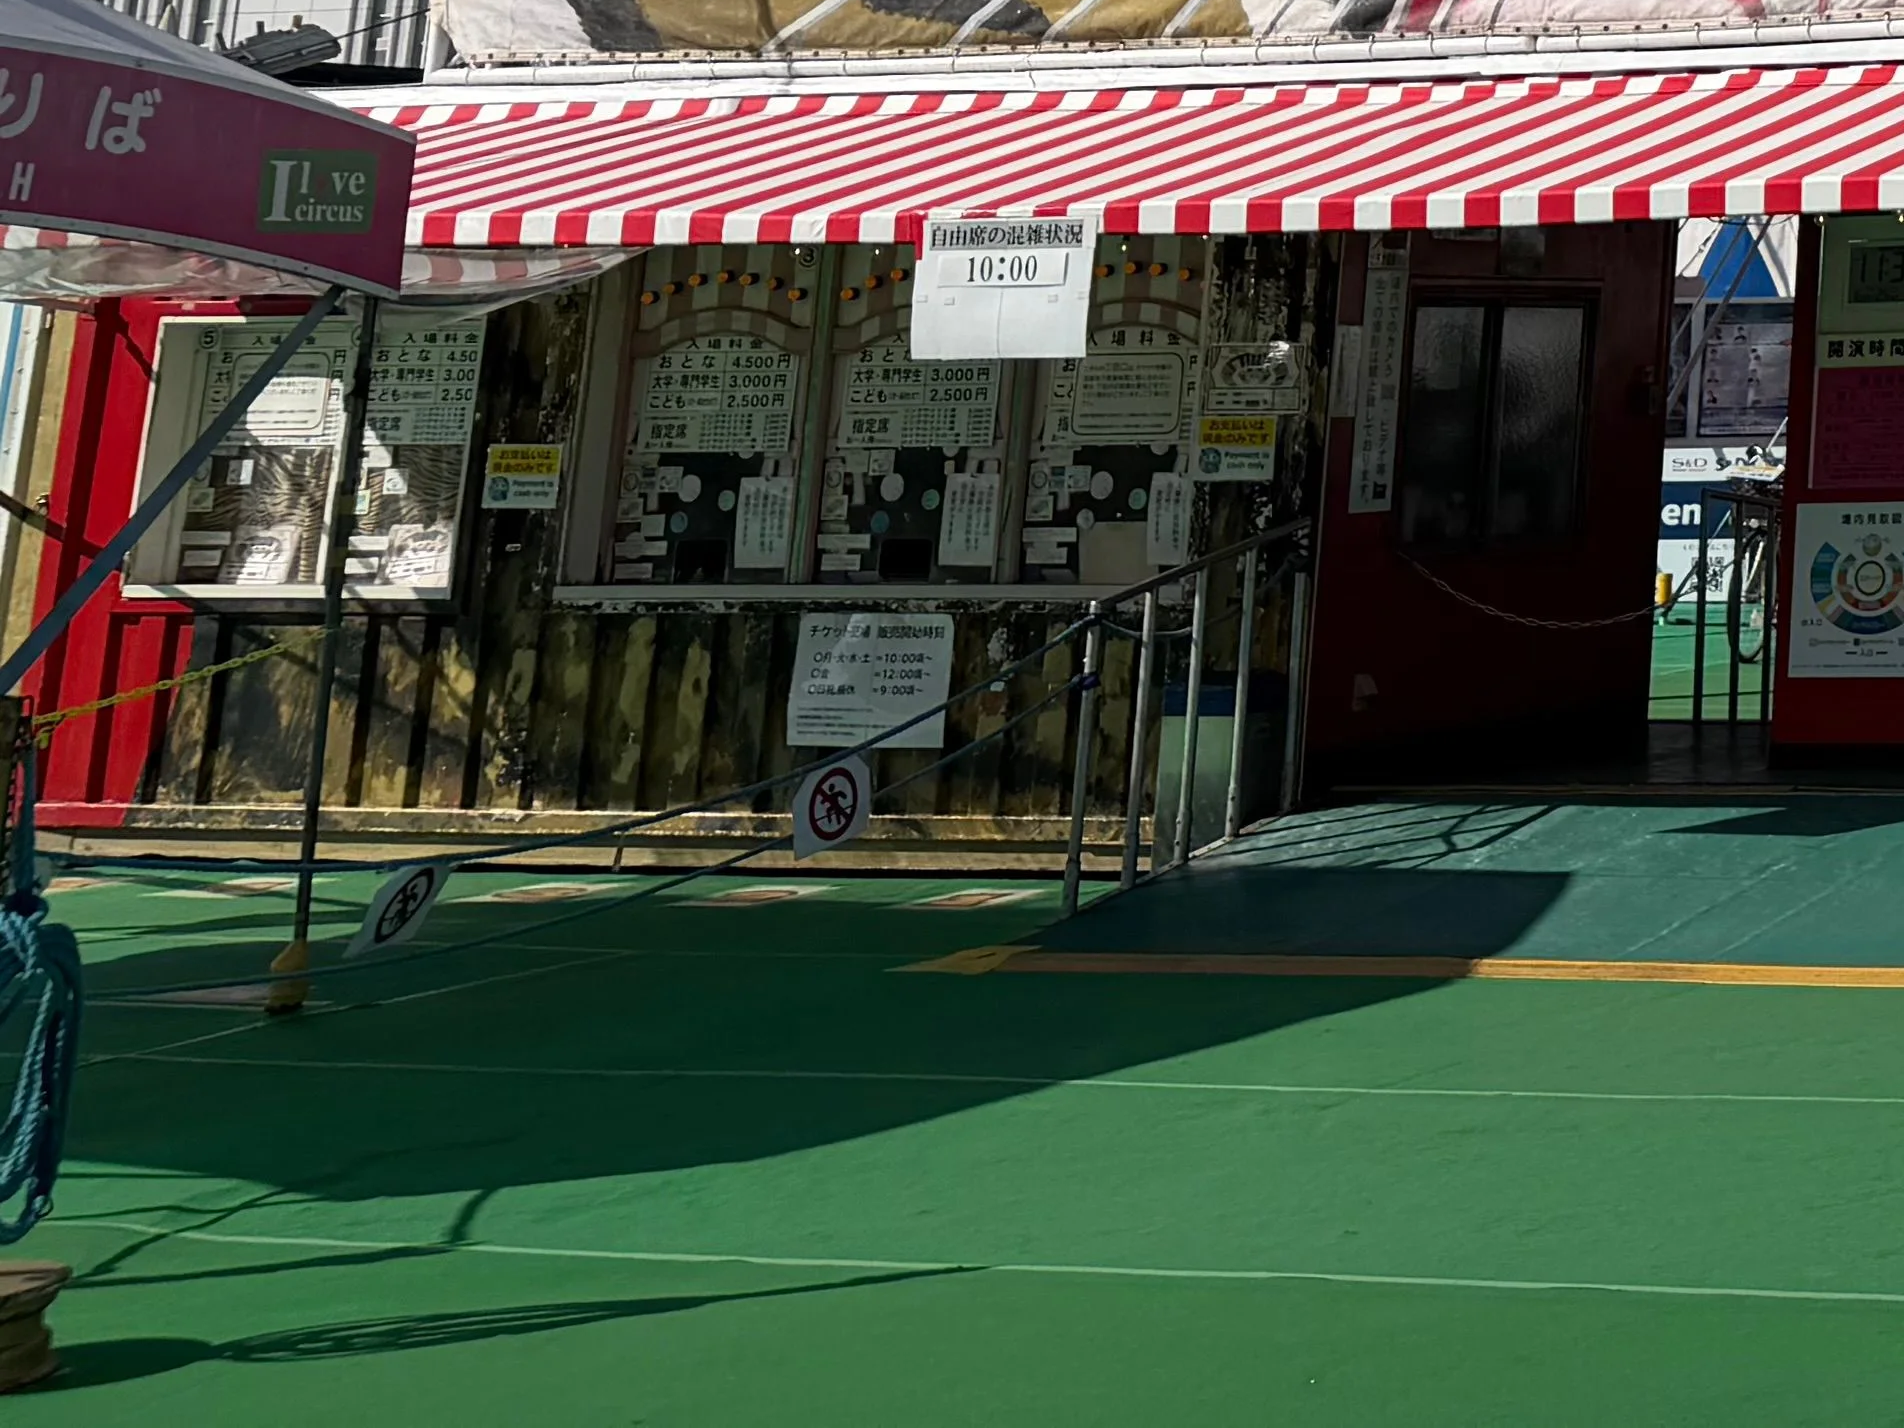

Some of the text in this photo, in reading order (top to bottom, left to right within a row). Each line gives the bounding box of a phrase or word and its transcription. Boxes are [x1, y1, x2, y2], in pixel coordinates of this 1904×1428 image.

[295, 197, 364, 222] circus
[931, 223, 1083, 248] 自由席の混雑状況
[967, 255, 1038, 283] 10:00
